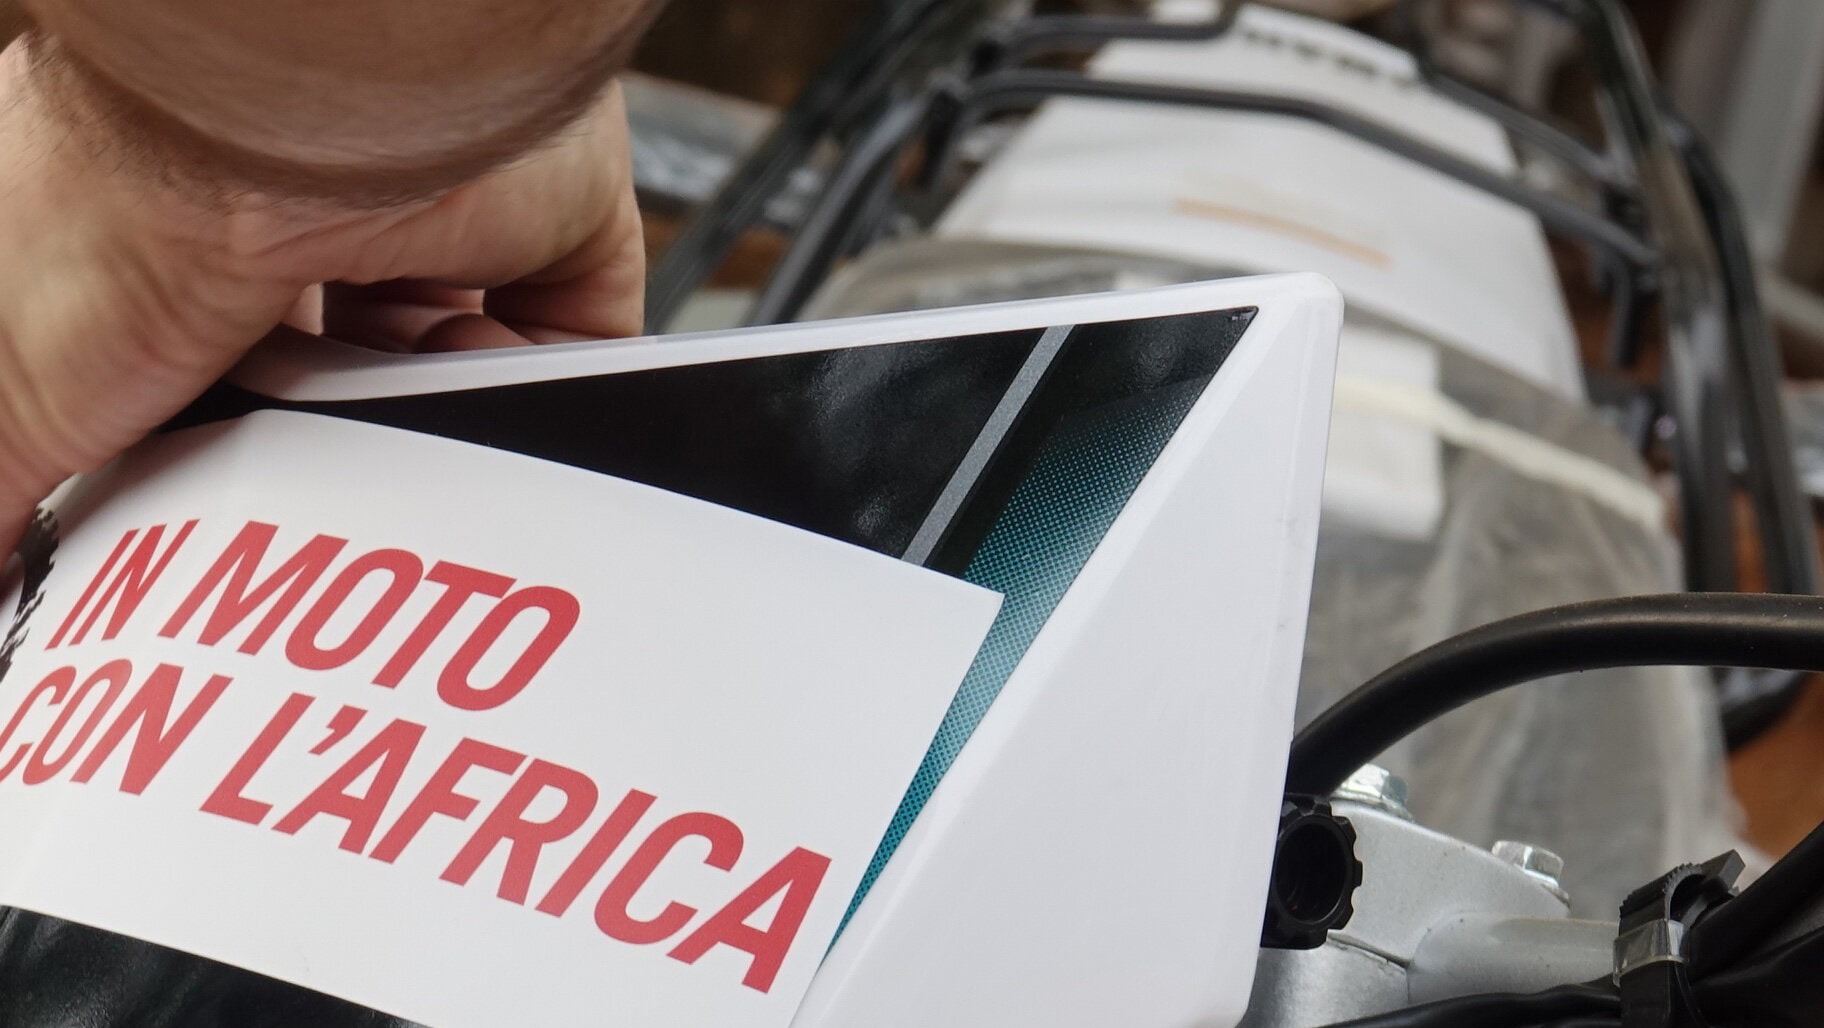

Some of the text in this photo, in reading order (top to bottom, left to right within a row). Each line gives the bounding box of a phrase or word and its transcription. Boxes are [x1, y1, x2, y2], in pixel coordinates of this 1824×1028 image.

[45, 519, 581, 712] IN MOTO
[200, 692, 832, 994] L'AFRICA
